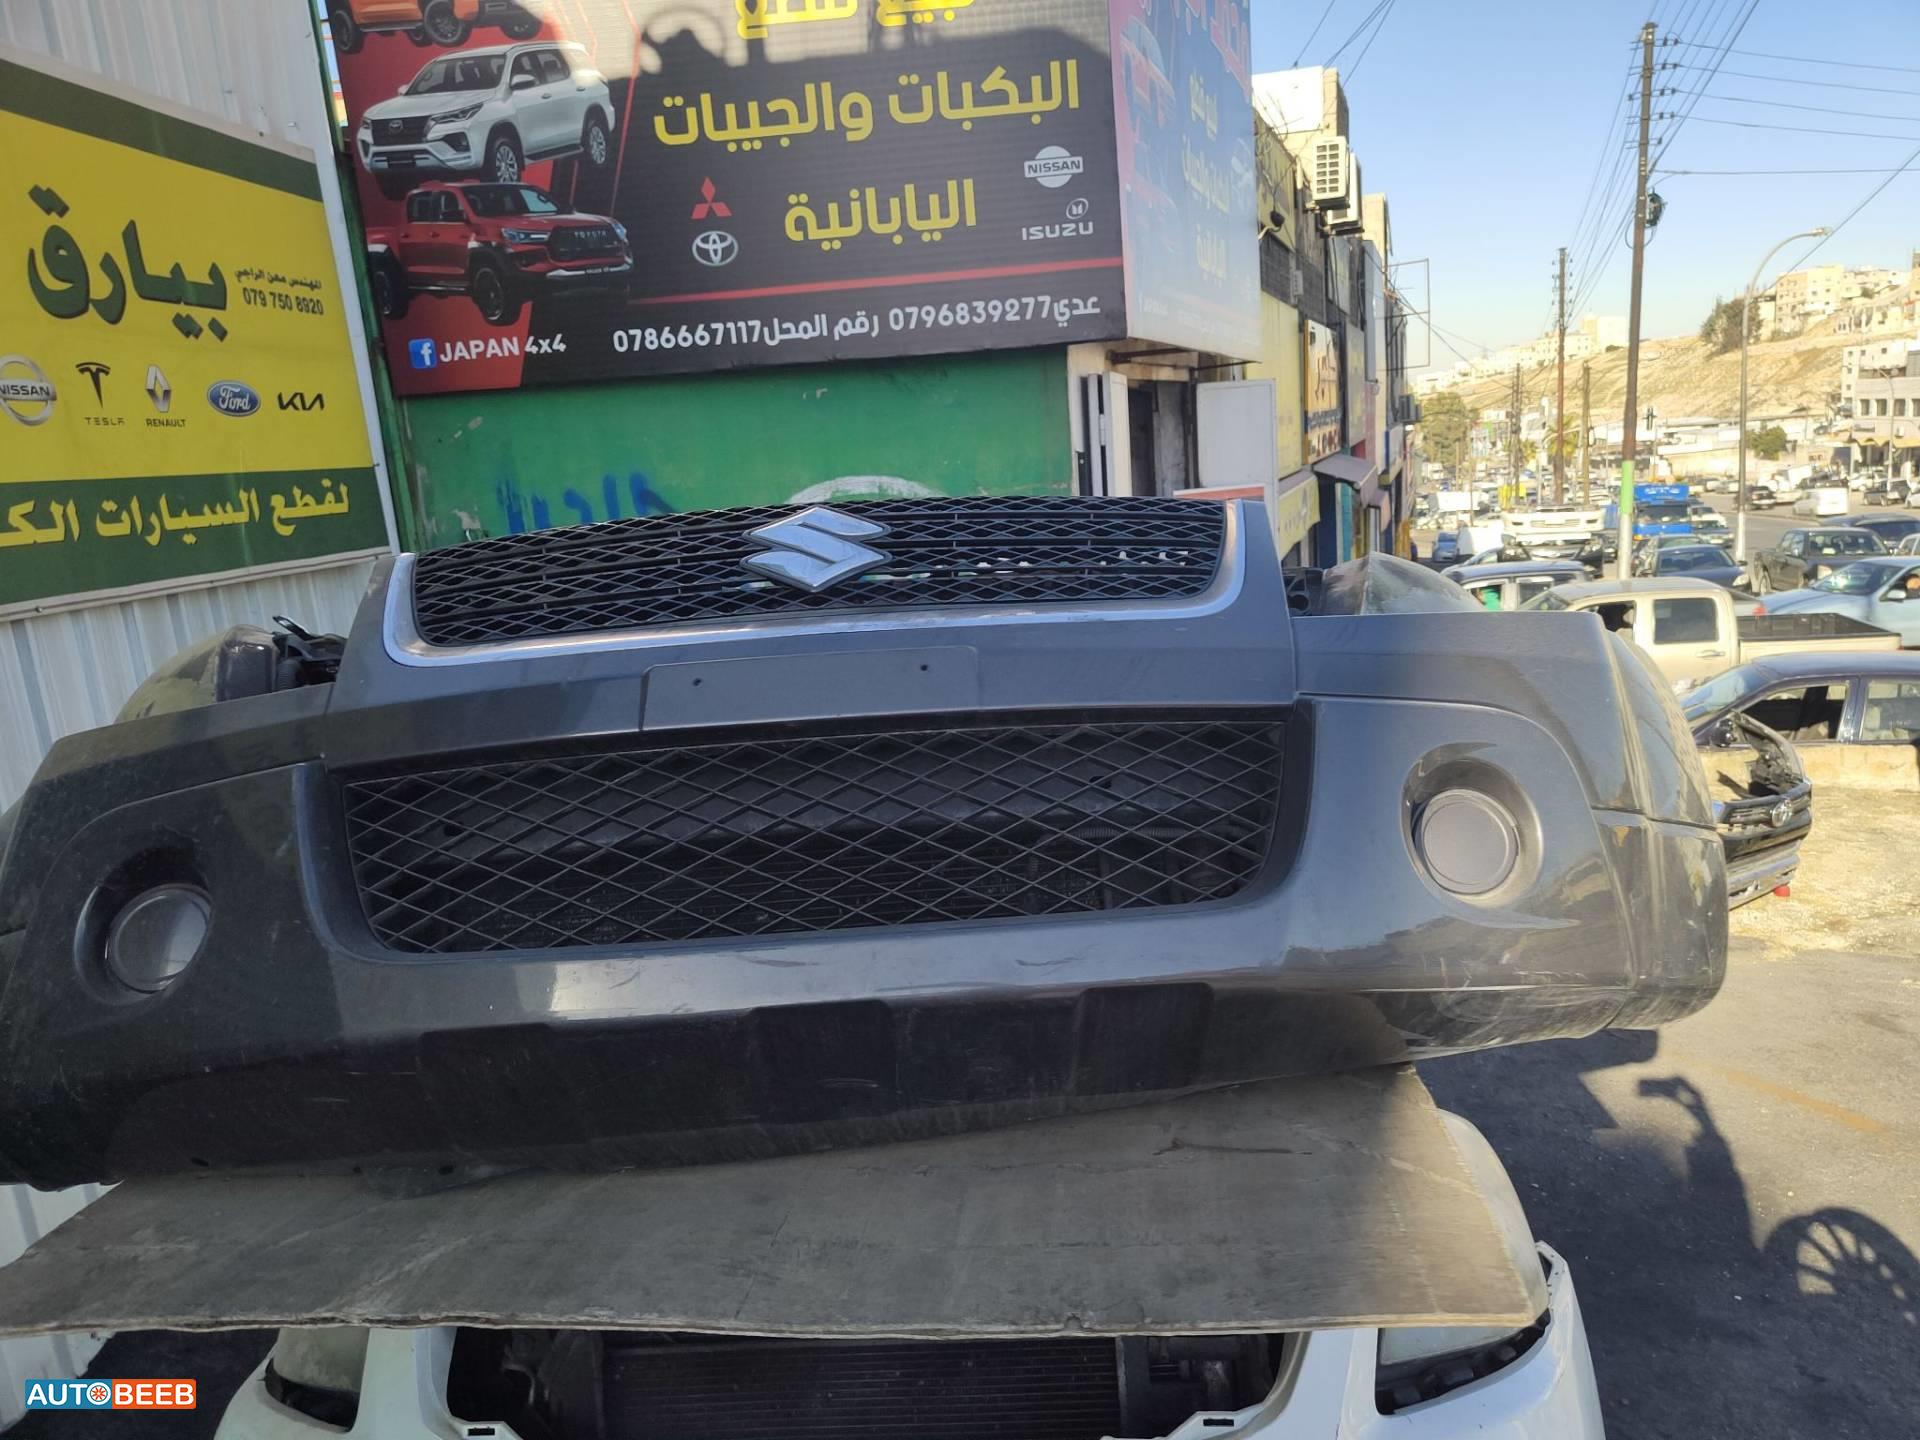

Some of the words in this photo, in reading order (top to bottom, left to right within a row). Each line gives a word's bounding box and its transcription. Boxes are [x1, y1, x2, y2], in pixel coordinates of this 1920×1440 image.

[888, 59, 1080, 131] البكبات
[653, 82, 874, 152] والجيبات
[1027, 159, 1081, 175] NISSAN
[784, 178, 977, 251] اليابانية
[1021, 221, 1094, 241] ISUZU
[28, 184, 228, 342] بيارق
[242, 287, 267, 307] 079
[269, 291, 293, 311] 750
[295, 296, 324, 315] 8920
[888, 295, 1051, 331] 0796839277
[612, 319, 761, 353] 0786667117
[833, 310, 880, 341] رقم
[440, 336, 520, 362] JAPAN
[524, 333, 567, 354] 4x4
[0, 385, 50, 397] NISSAN
[218, 385, 251, 411] Ford
[85, 416, 125, 426] TESLA
[146, 418, 187, 428] RENAULT
[96, 487, 260, 546] السيارات
[270, 478, 349, 537] لقطع
